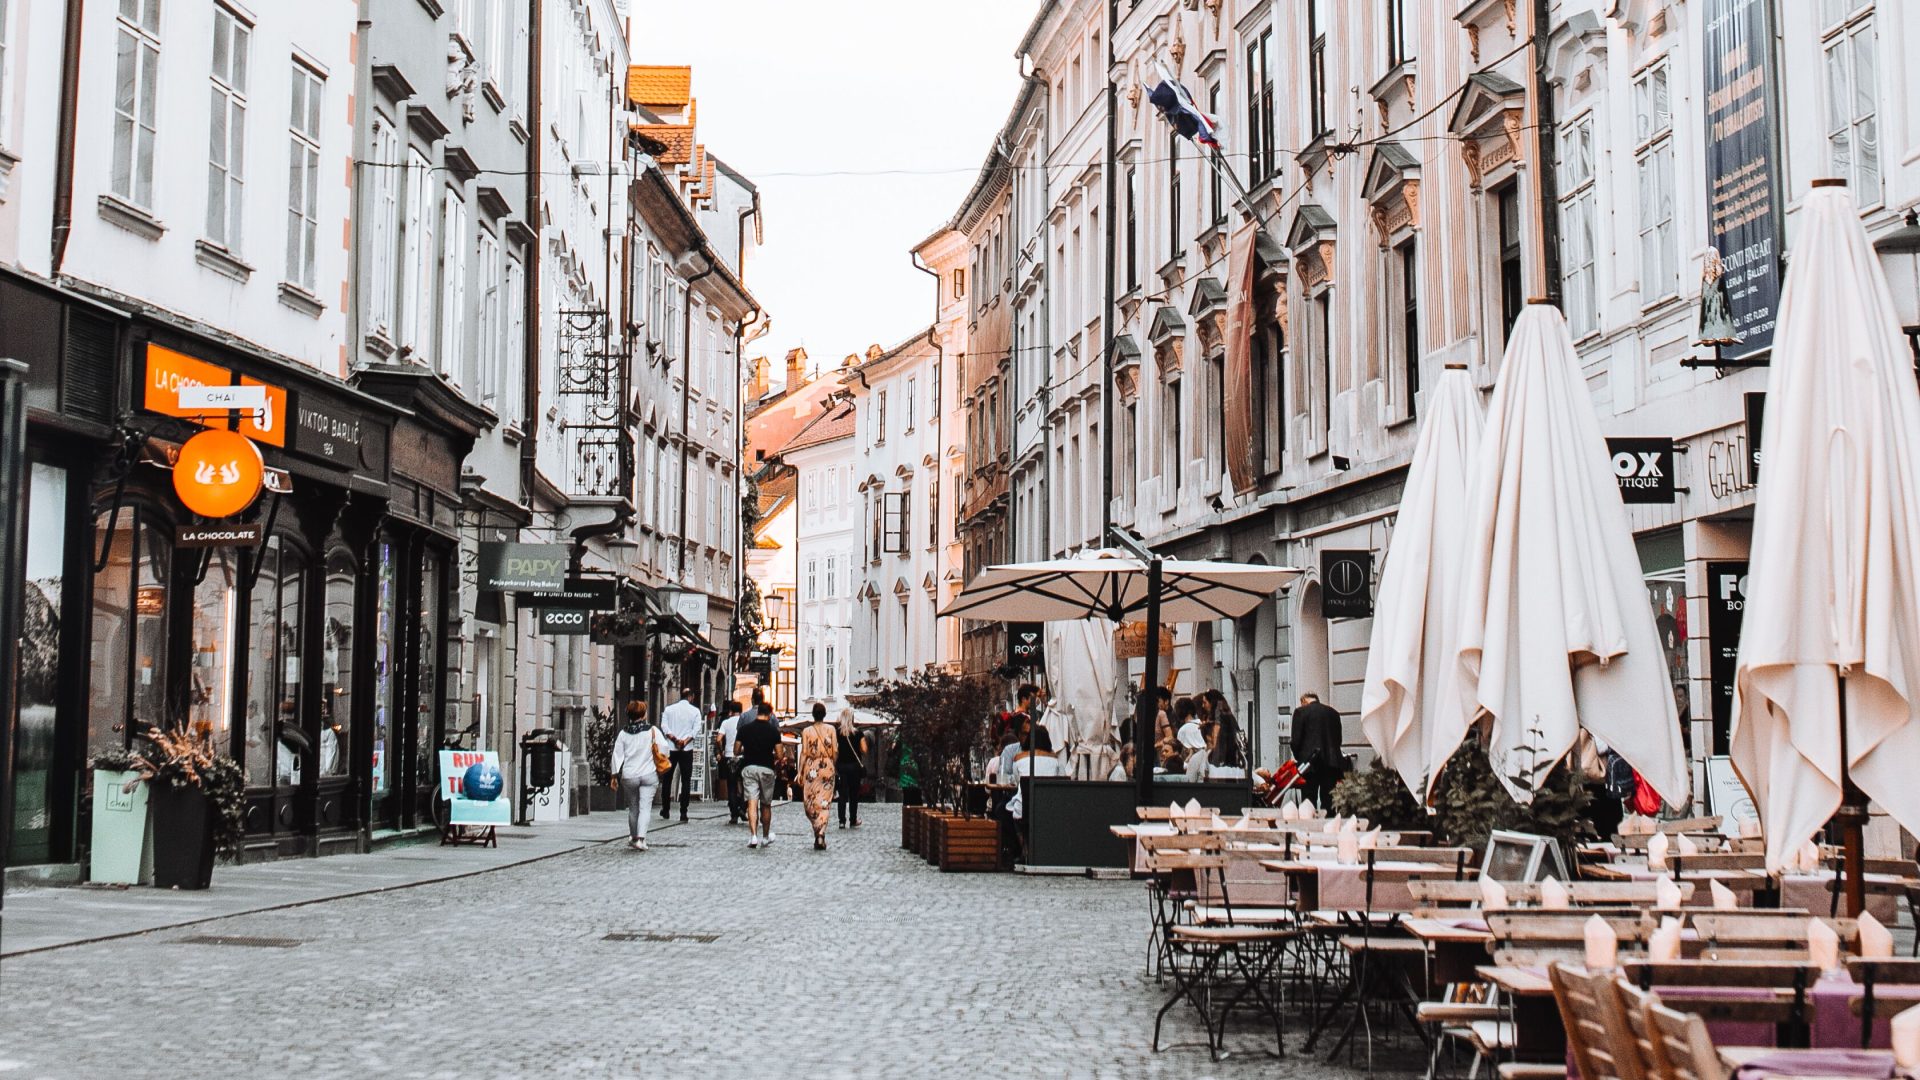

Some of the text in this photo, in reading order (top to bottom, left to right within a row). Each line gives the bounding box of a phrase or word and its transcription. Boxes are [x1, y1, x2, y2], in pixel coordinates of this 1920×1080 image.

[1721, 250, 1744, 273] SCONTI
[154, 368, 168, 389] LA
[207, 393, 235, 402] CHAI
[298, 407, 329, 434] VIKTOR
[1612, 452, 1663, 477] OX
[1709, 433, 1757, 499] GAL
[1753, 451, 1761, 465] S
[1618, 478, 1658, 489] UTIQUE
[183, 531, 255, 541] LA CHOCOLATE
[507, 558, 560, 576] PAPY
[1727, 601, 1743, 611] BO
[545, 613, 583, 624] ecco
